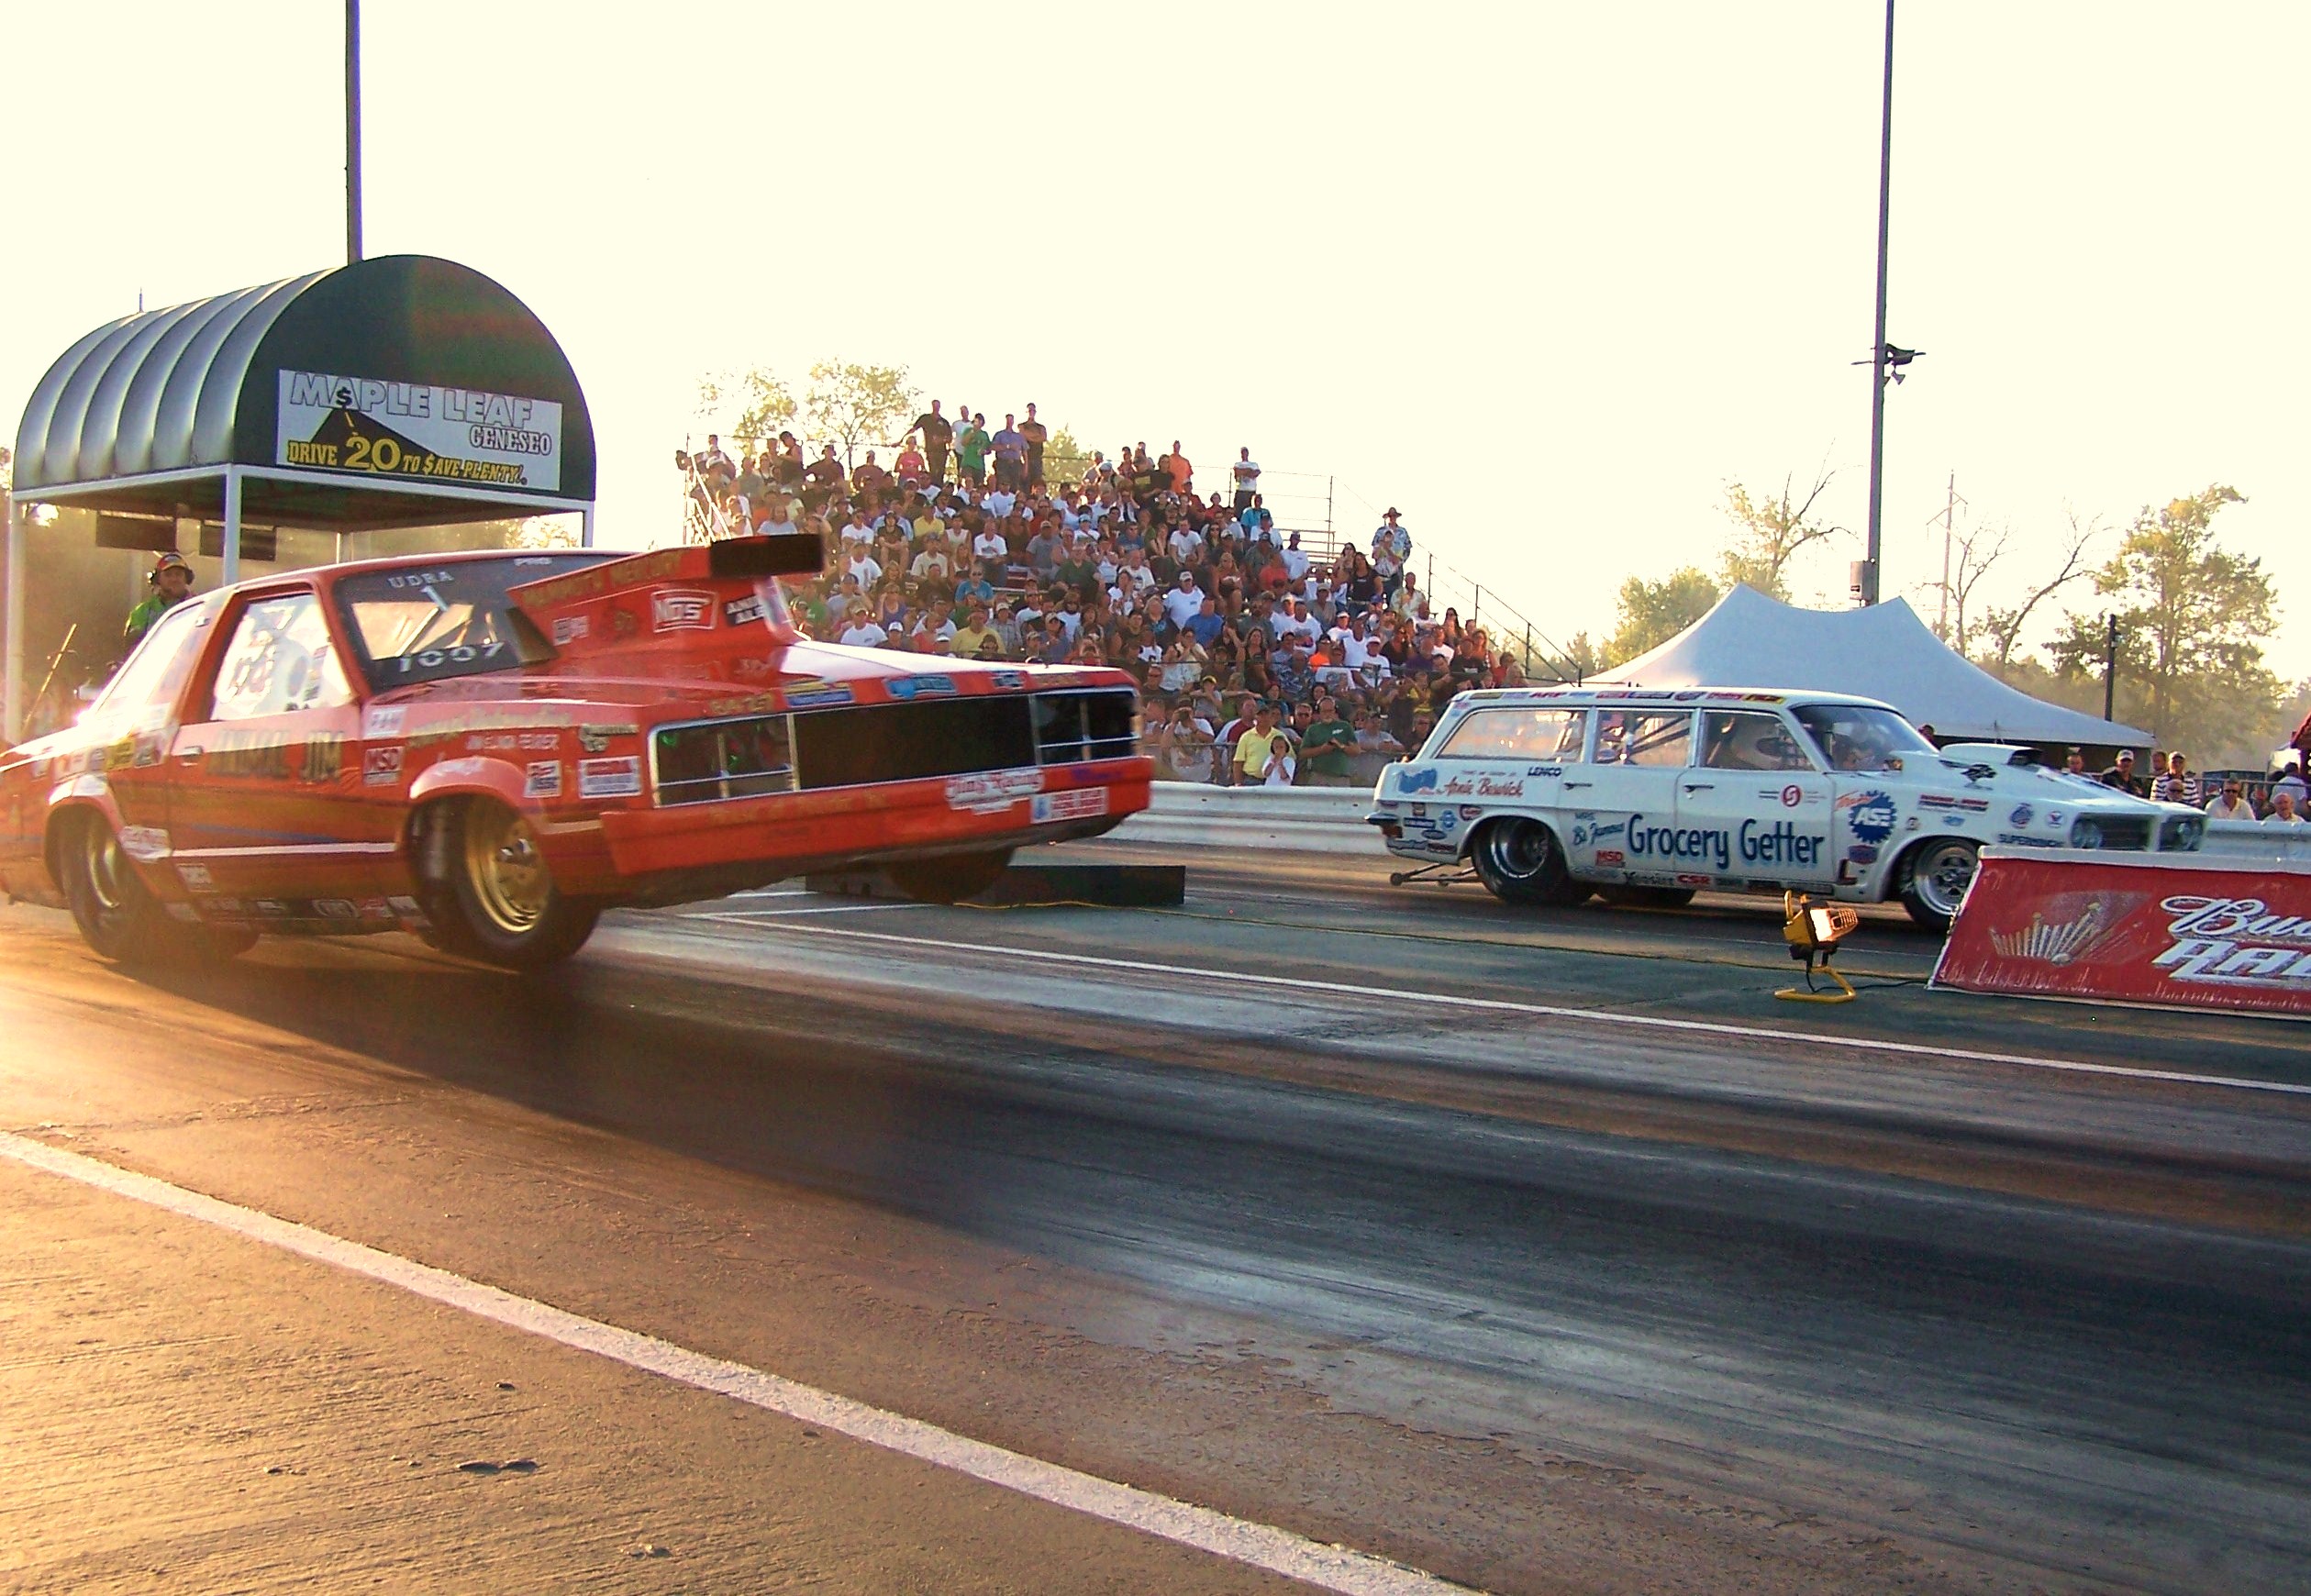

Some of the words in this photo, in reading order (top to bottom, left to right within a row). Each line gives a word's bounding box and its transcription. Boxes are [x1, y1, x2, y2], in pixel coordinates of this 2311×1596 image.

[443, 388, 533, 429] LEAF
[287, 439, 338, 466] DRIVE
[344, 435, 401, 471] 20
[403, 455, 420, 473] TO
[469, 426, 552, 455] GENESEO
[387, 571, 455, 589] UDRA
[1853, 807, 1891, 826] ASE
[1596, 849, 1624, 861] MSD
[1628, 814, 1729, 870] Grocery
[1741, 818, 1825, 864] Getter
